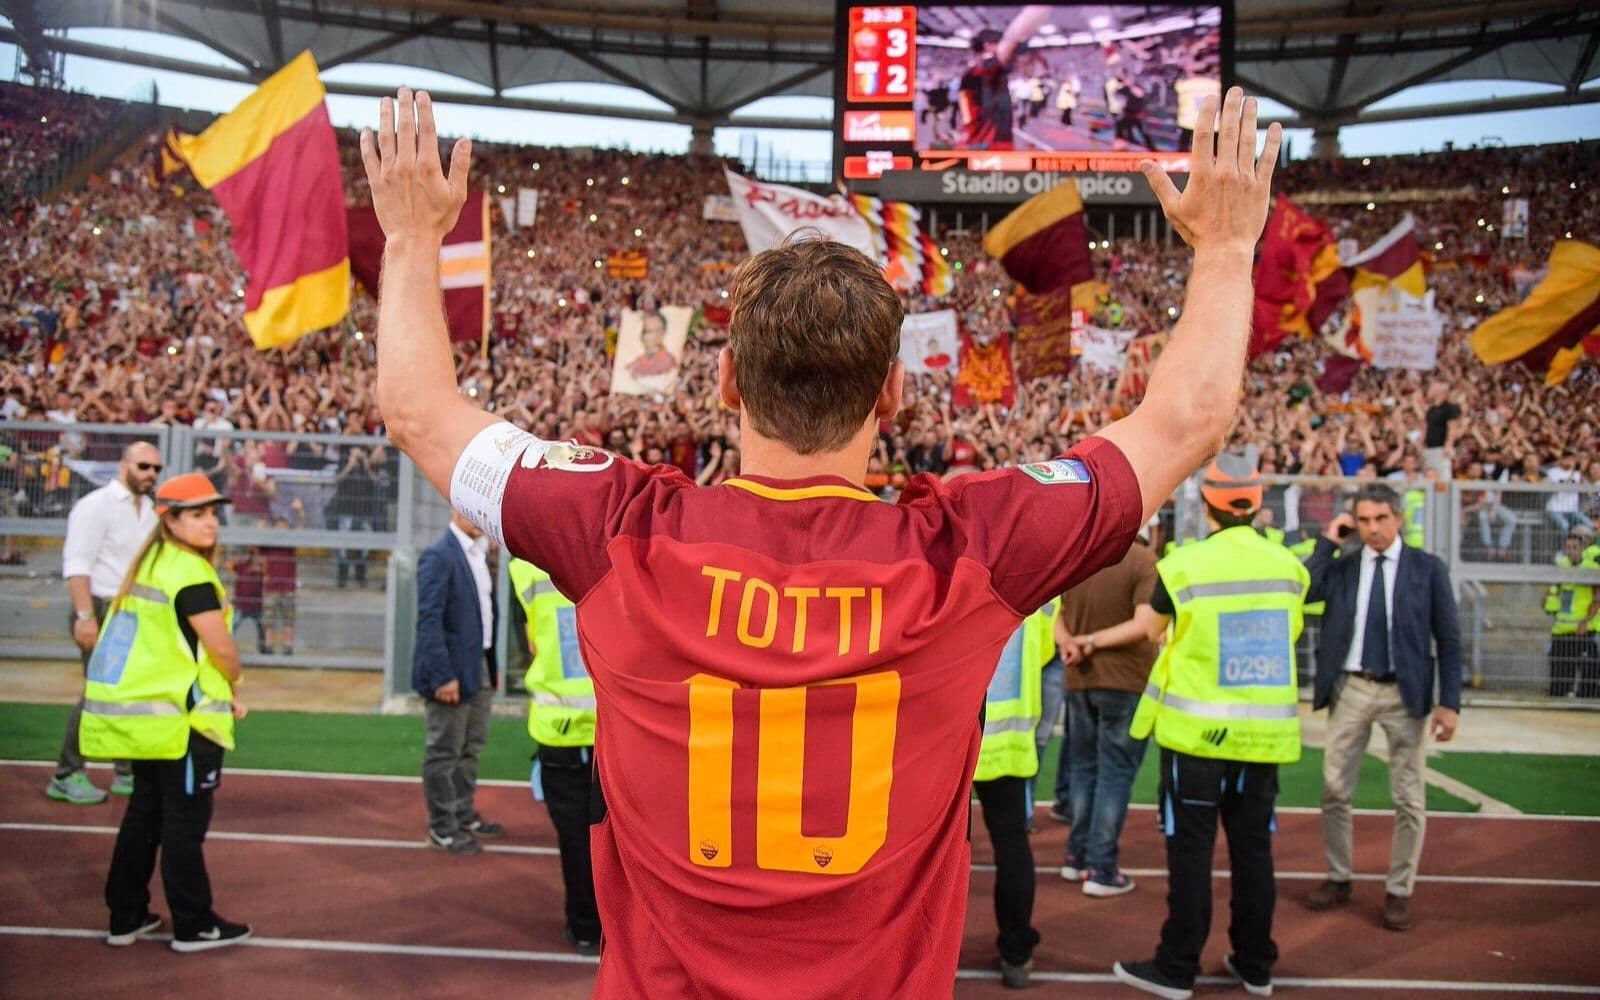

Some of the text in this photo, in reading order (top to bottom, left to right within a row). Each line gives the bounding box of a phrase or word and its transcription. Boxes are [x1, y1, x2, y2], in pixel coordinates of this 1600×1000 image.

[886, 28, 908, 58] 3
[887, 65, 908, 94] 2
[942, 171, 1020, 194] Stadio
[701, 565, 883, 656] TOTTI
[1224, 655, 1285, 681] 0296
[681, 670, 901, 875] 10
